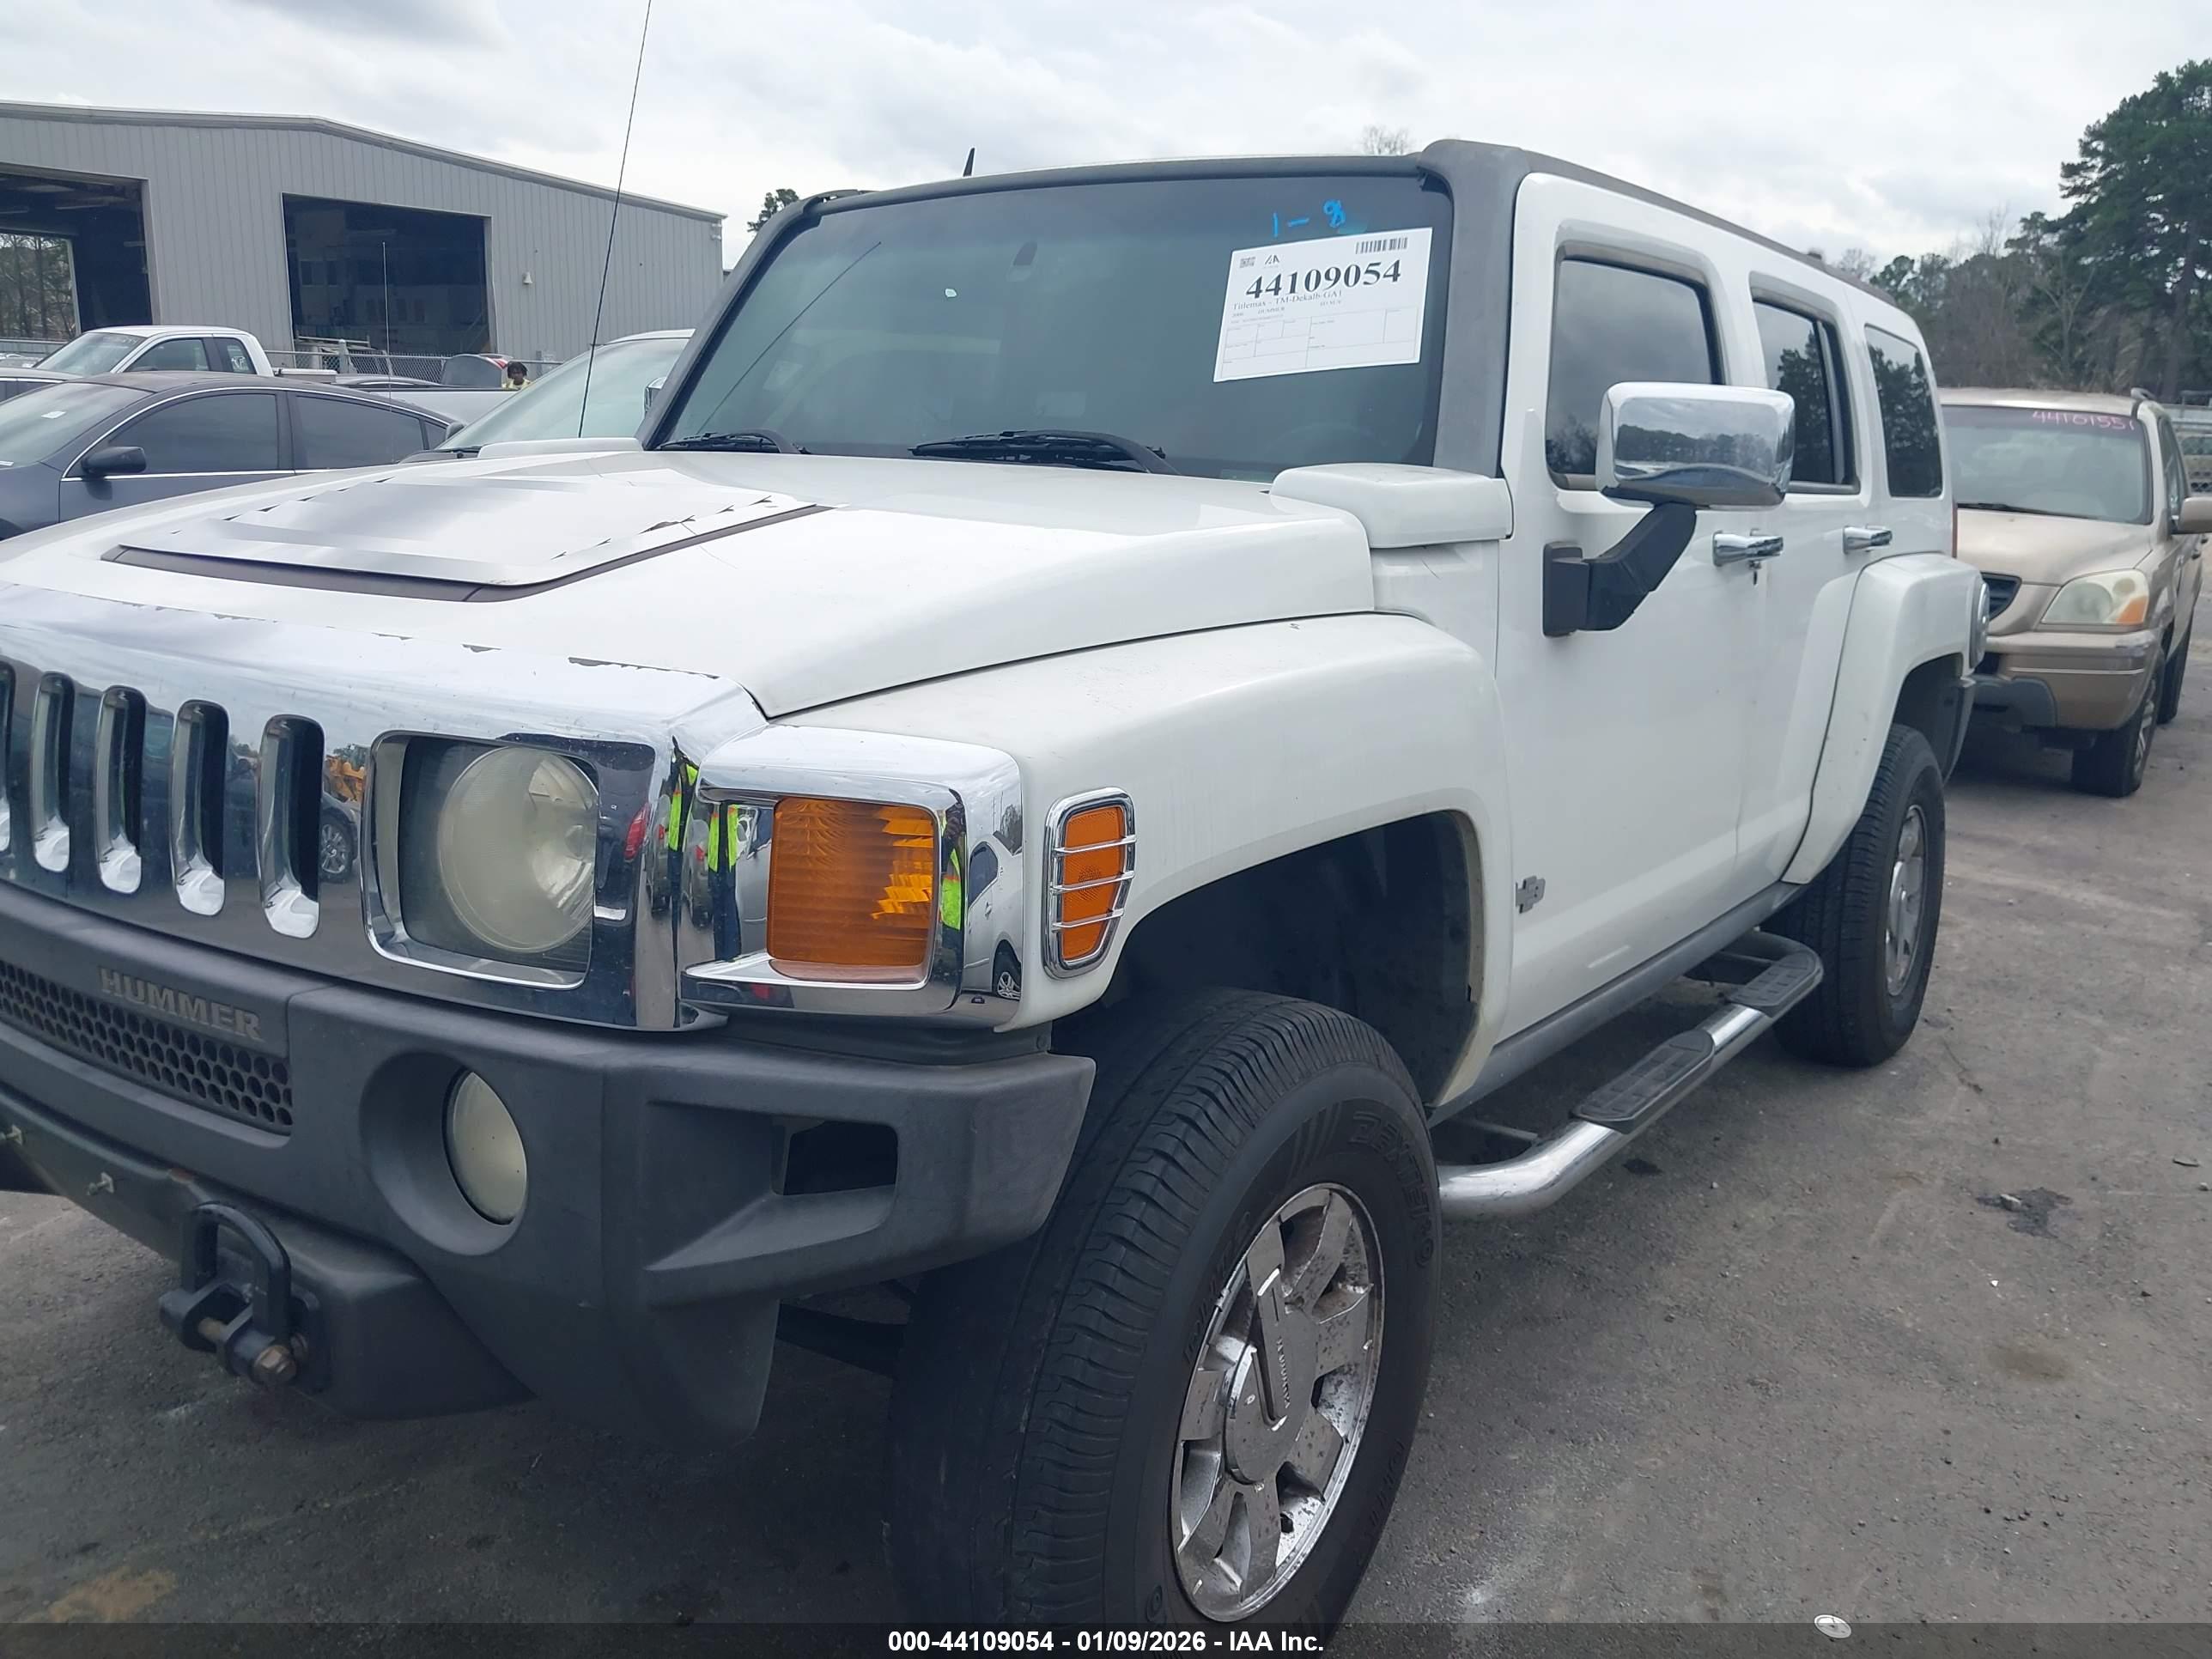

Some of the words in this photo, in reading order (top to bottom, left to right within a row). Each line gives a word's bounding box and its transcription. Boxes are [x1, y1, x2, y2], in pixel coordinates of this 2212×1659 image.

[1245, 259, 1401, 299] 44109054
[1233, 301, 1267, 310] Titlemax
[99, 965, 266, 1042] HUMMER
